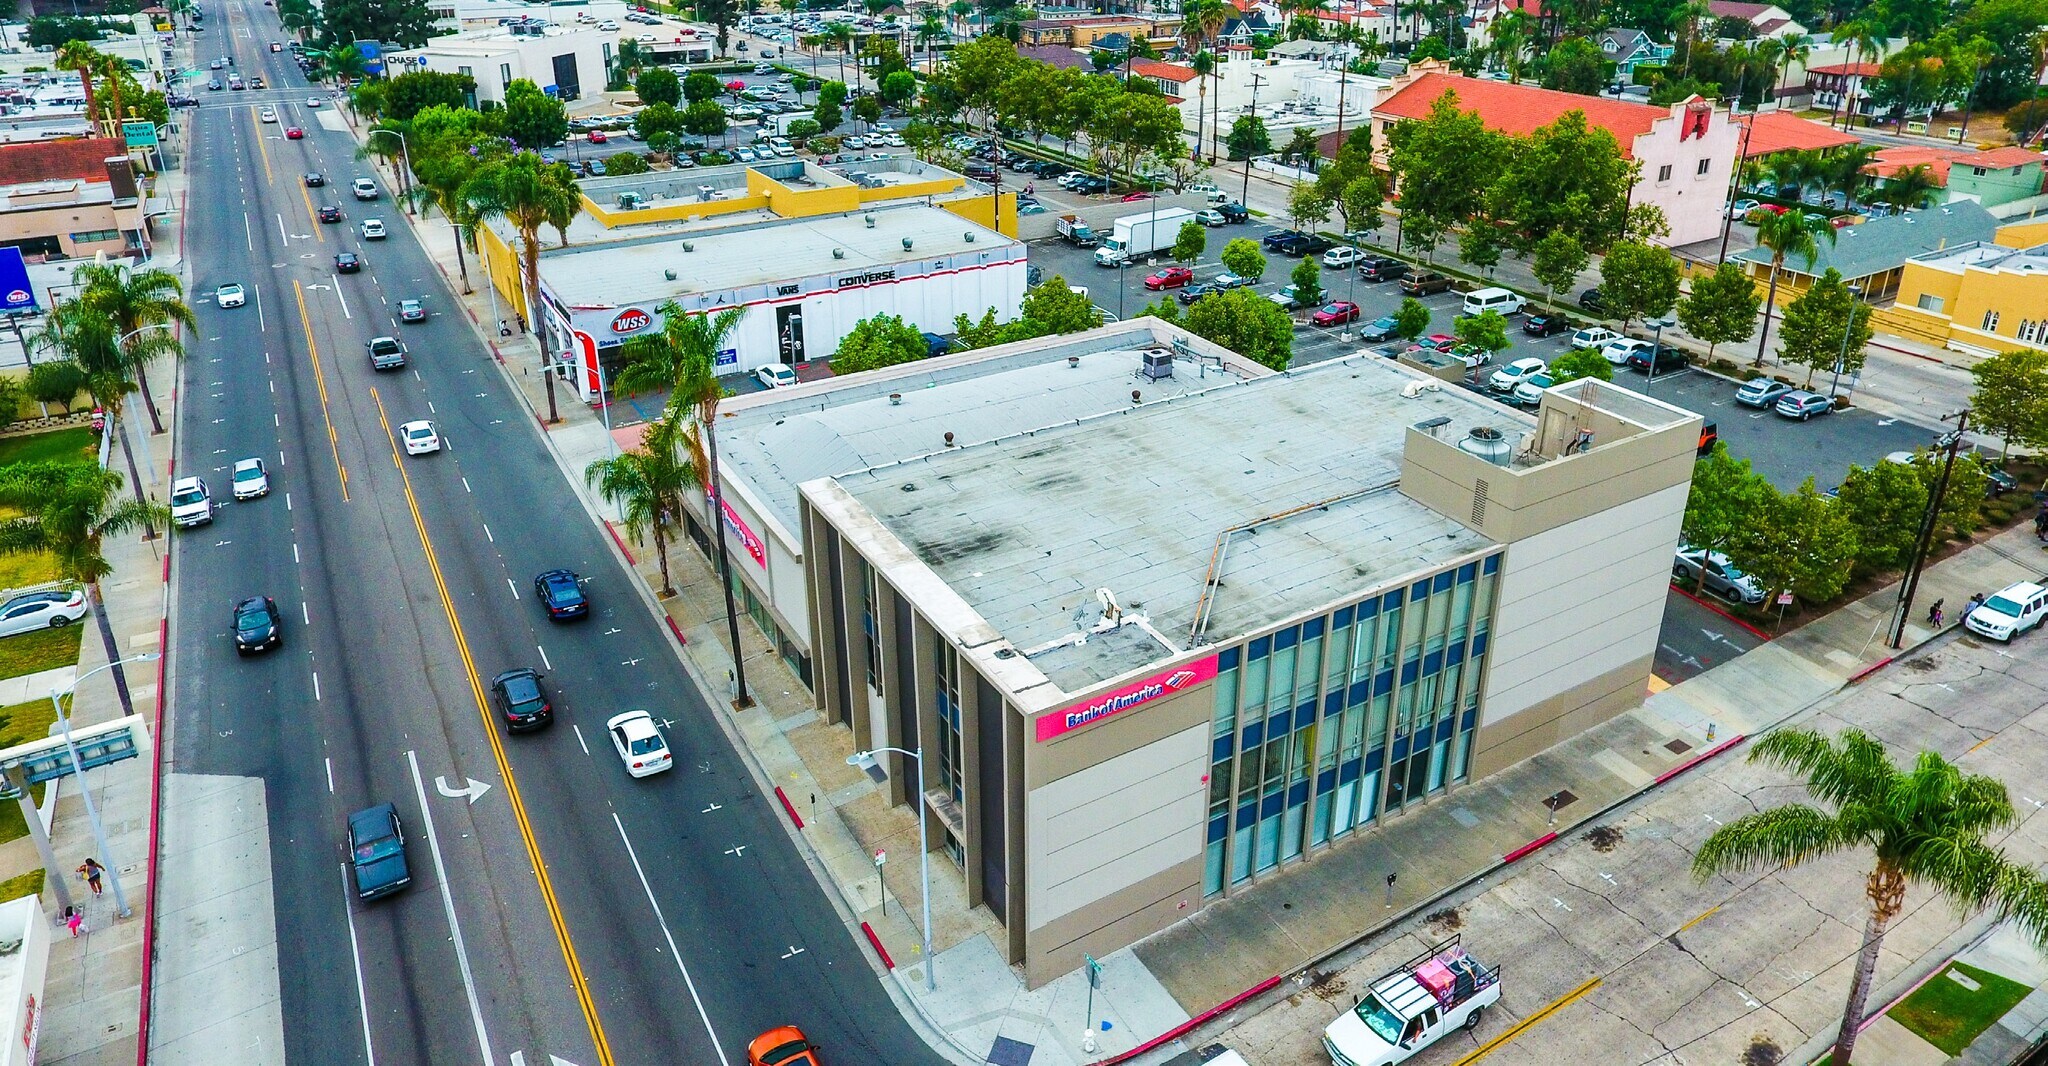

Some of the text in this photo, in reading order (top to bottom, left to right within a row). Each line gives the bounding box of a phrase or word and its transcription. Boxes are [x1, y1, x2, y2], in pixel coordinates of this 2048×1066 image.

[388, 56, 418, 64] CHASE
[838, 270, 896, 287] CONVERSE
[776, 284, 799, 296] VANS
[10, 293, 26, 301] WSS
[616, 315, 647, 330] WSS
[1066, 684, 1163, 728] Bank of America
